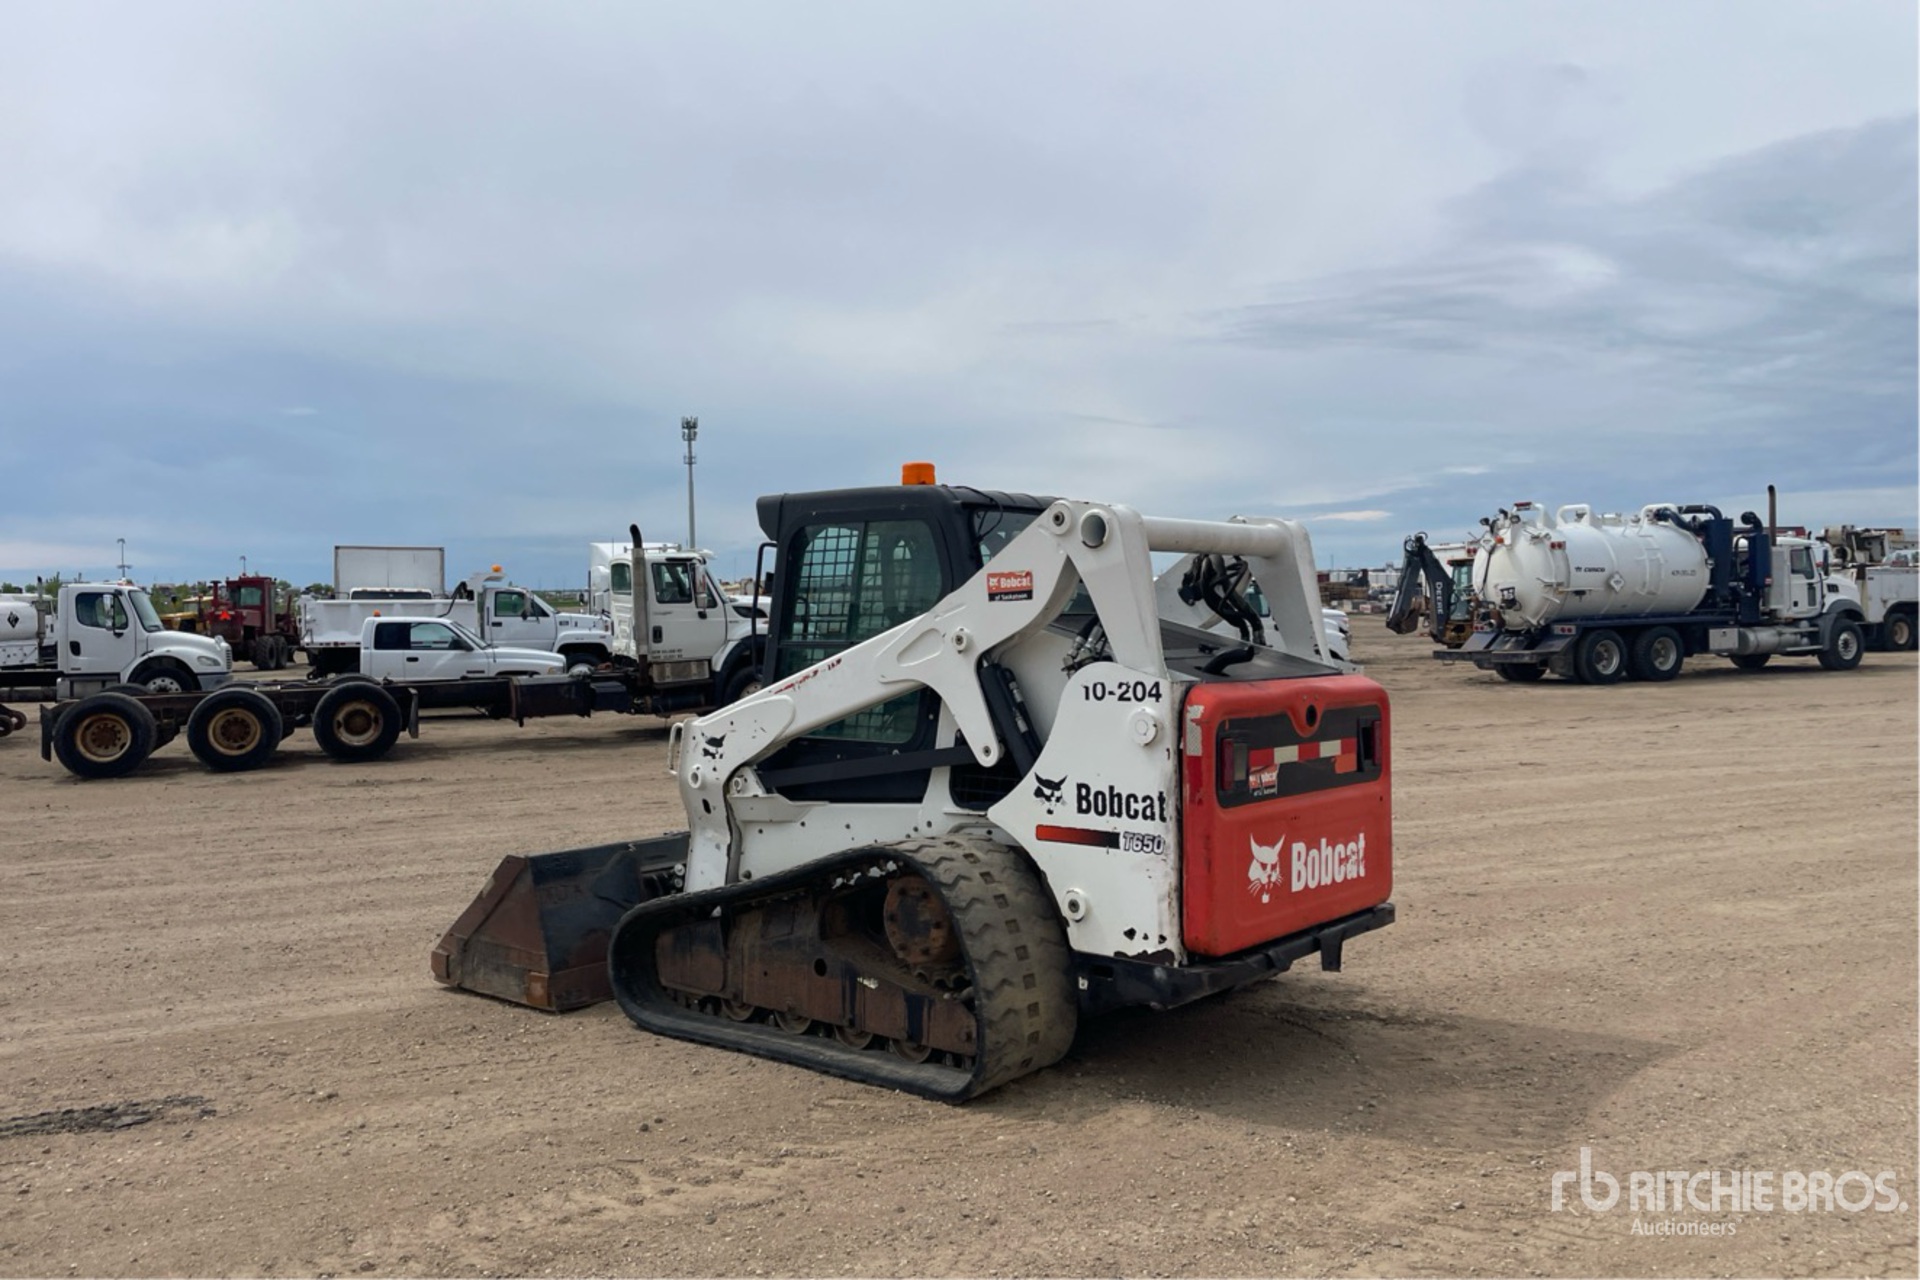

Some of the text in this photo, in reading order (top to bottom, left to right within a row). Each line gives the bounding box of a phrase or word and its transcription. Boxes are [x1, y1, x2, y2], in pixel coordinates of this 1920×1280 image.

[1000, 576, 1031, 588] Bobcat
[1435, 581, 1444, 615] DEERE
[1082, 681, 1162, 703] 10-204
[1076, 782, 1167, 823] Bobcat
[1122, 831, 1165, 855] T650
[1291, 832, 1366, 893] Bobcat
